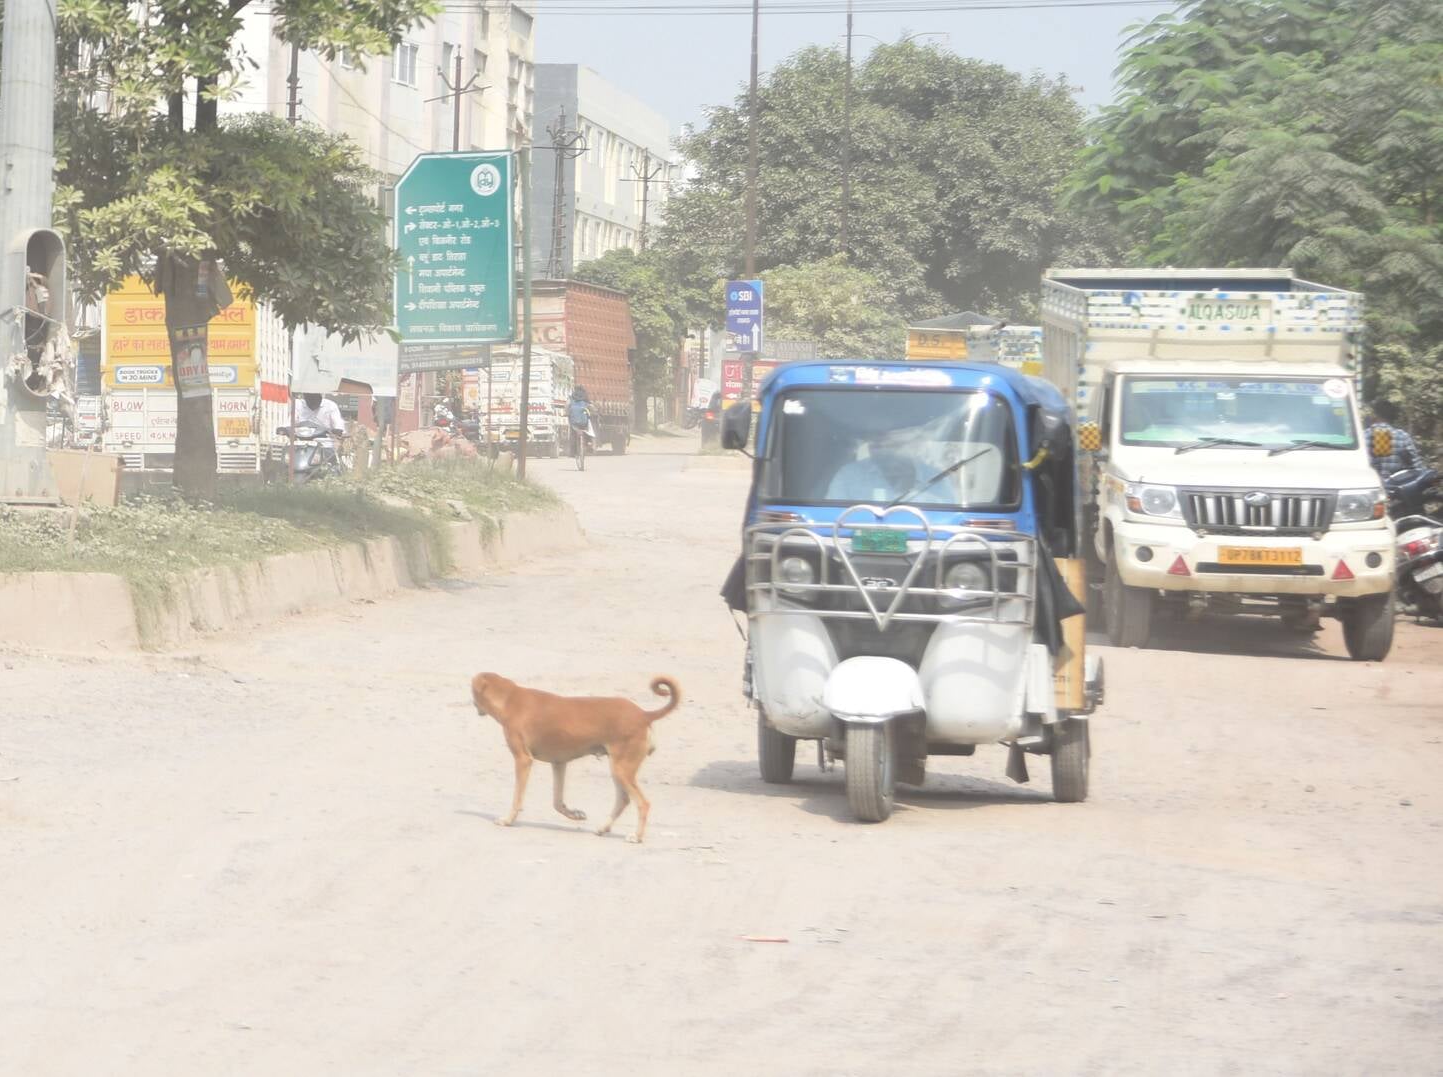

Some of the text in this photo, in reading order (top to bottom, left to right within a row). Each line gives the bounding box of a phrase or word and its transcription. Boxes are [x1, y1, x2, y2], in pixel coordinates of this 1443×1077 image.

[739, 291, 752, 300] SBI
[113, 402, 247, 411] BLOW HORN
